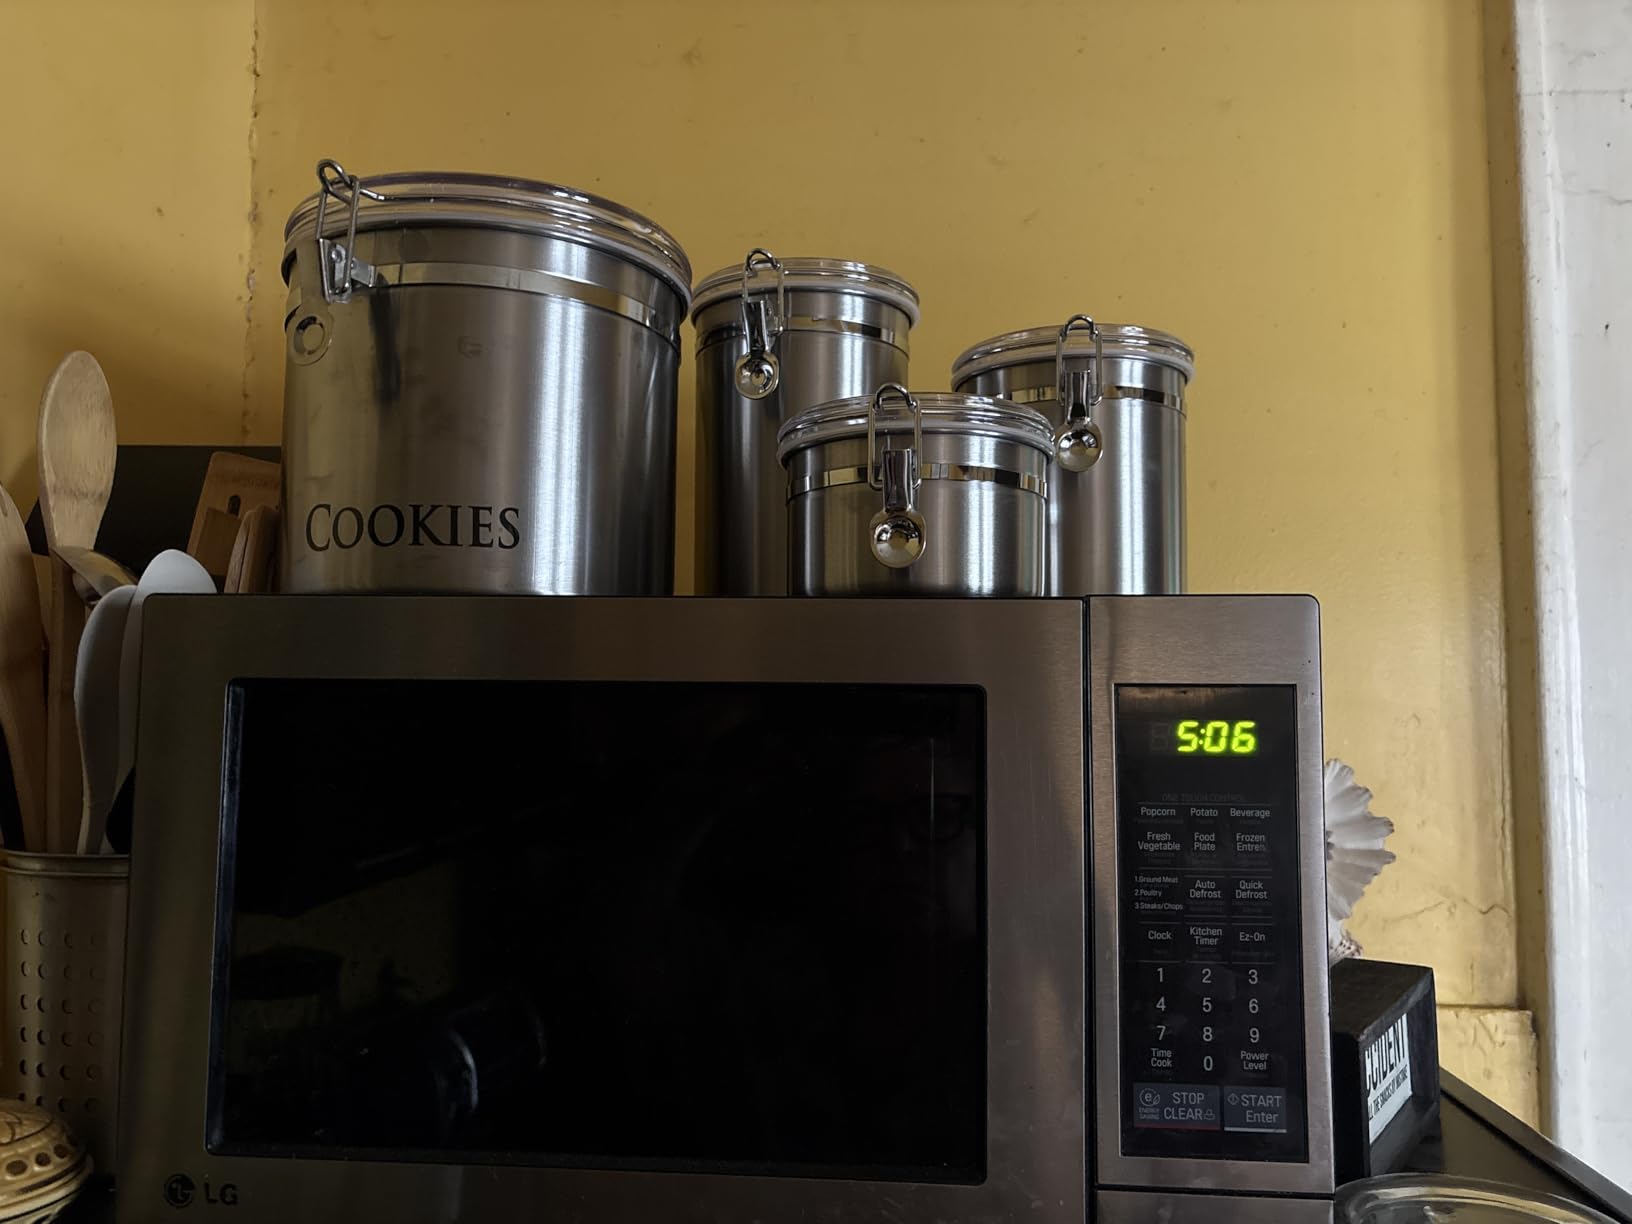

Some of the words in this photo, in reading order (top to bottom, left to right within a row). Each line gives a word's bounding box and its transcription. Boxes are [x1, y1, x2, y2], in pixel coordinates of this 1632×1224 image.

[305, 503, 520, 552] COOKIES
[1176, 720, 1258, 754] 5:06
[1140, 806, 1176, 818] Popcorn
[1190, 807, 1218, 817] Potato
[1230, 808, 1271, 819] Beverage
[1146, 831, 1171, 841] Fresh
[1194, 832, 1216, 842] Food
[1236, 832, 1266, 842] Frozen
[1137, 841, 1181, 852] Vegetable
[1194, 842, 1216, 851] Plate
[1162, 876, 1179, 884] Meat
[1194, 879, 1216, 889] Auto
[1239, 880, 1264, 890] Quick
[1189, 889, 1222, 899] Defrost
[1235, 890, 1268, 900] Defrost
[1147, 930, 1173, 940] Clock
[1189, 926, 1223, 936] Kitchen
[1194, 936, 1218, 946] Timer
[1239, 932, 1266, 942] Ez-On
[1156, 967, 1164, 983] 1
[1201, 968, 1212, 984] 2
[1248, 969, 1259, 985] 3
[1156, 996, 1167, 1012] 4
[1202, 997, 1213, 1013] 5
[1248, 998, 1259, 1014] 6
[1156, 1025, 1166, 1041] 7
[1202, 1026, 1213, 1042] 8
[1249, 1027, 1260, 1043] 9
[1150, 1048, 1173, 1058] Time
[1240, 1050, 1270, 1061] Power
[1151, 1058, 1173, 1068] Cook
[1203, 1055, 1214, 1072] 0
[1243, 1061, 1267, 1072] Level
[1172, 1091, 1205, 1105] STOP
[1240, 1094, 1282, 1107] START
[1163, 1107, 1203, 1120] CLEAR
[1245, 1110, 1279, 1123] Enter
[204, 1182, 238, 1206] LG
